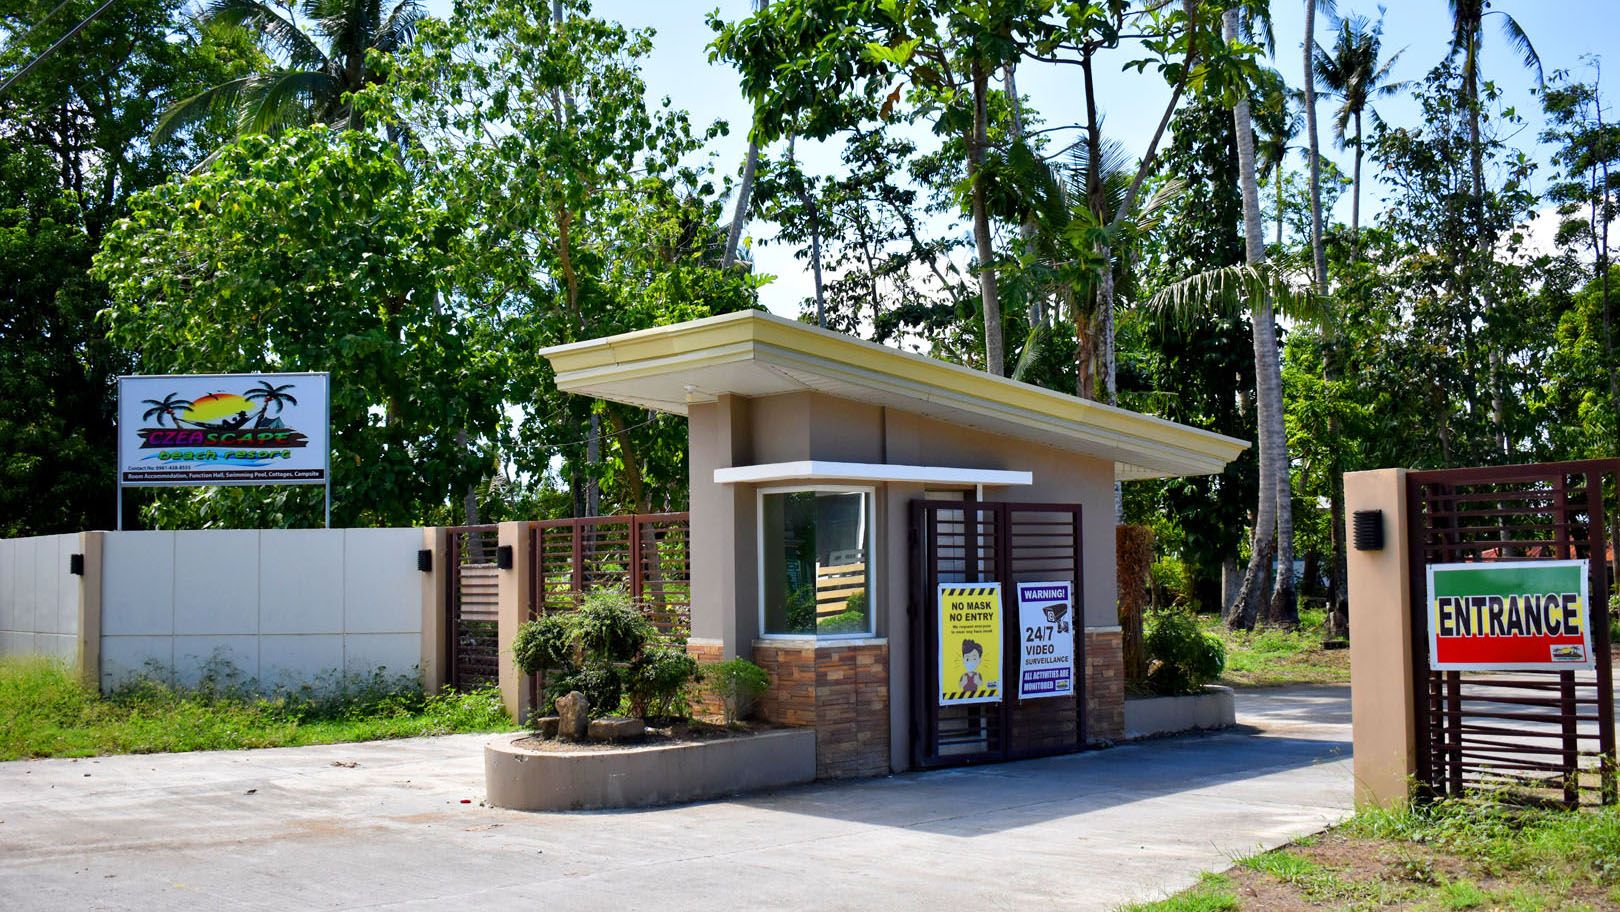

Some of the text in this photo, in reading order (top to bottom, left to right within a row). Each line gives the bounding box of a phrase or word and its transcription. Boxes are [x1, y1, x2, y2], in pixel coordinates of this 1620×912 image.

[158, 449, 291, 460] beach resort
[1024, 588, 1065, 600] WARNING!
[951, 601, 992, 611] NO MASK
[950, 612, 994, 622] NO ENTRY
[1438, 593, 1580, 637] ENTRANCE
[1025, 626, 1054, 642] 24/7
[1026, 644, 1055, 656] VIDEO
[1025, 656, 1069, 666] SURVEILLANCE
[1024, 669, 1070, 681] ALL ACTIVITIES ARE
[1024, 681, 1054, 691] MONITORED
